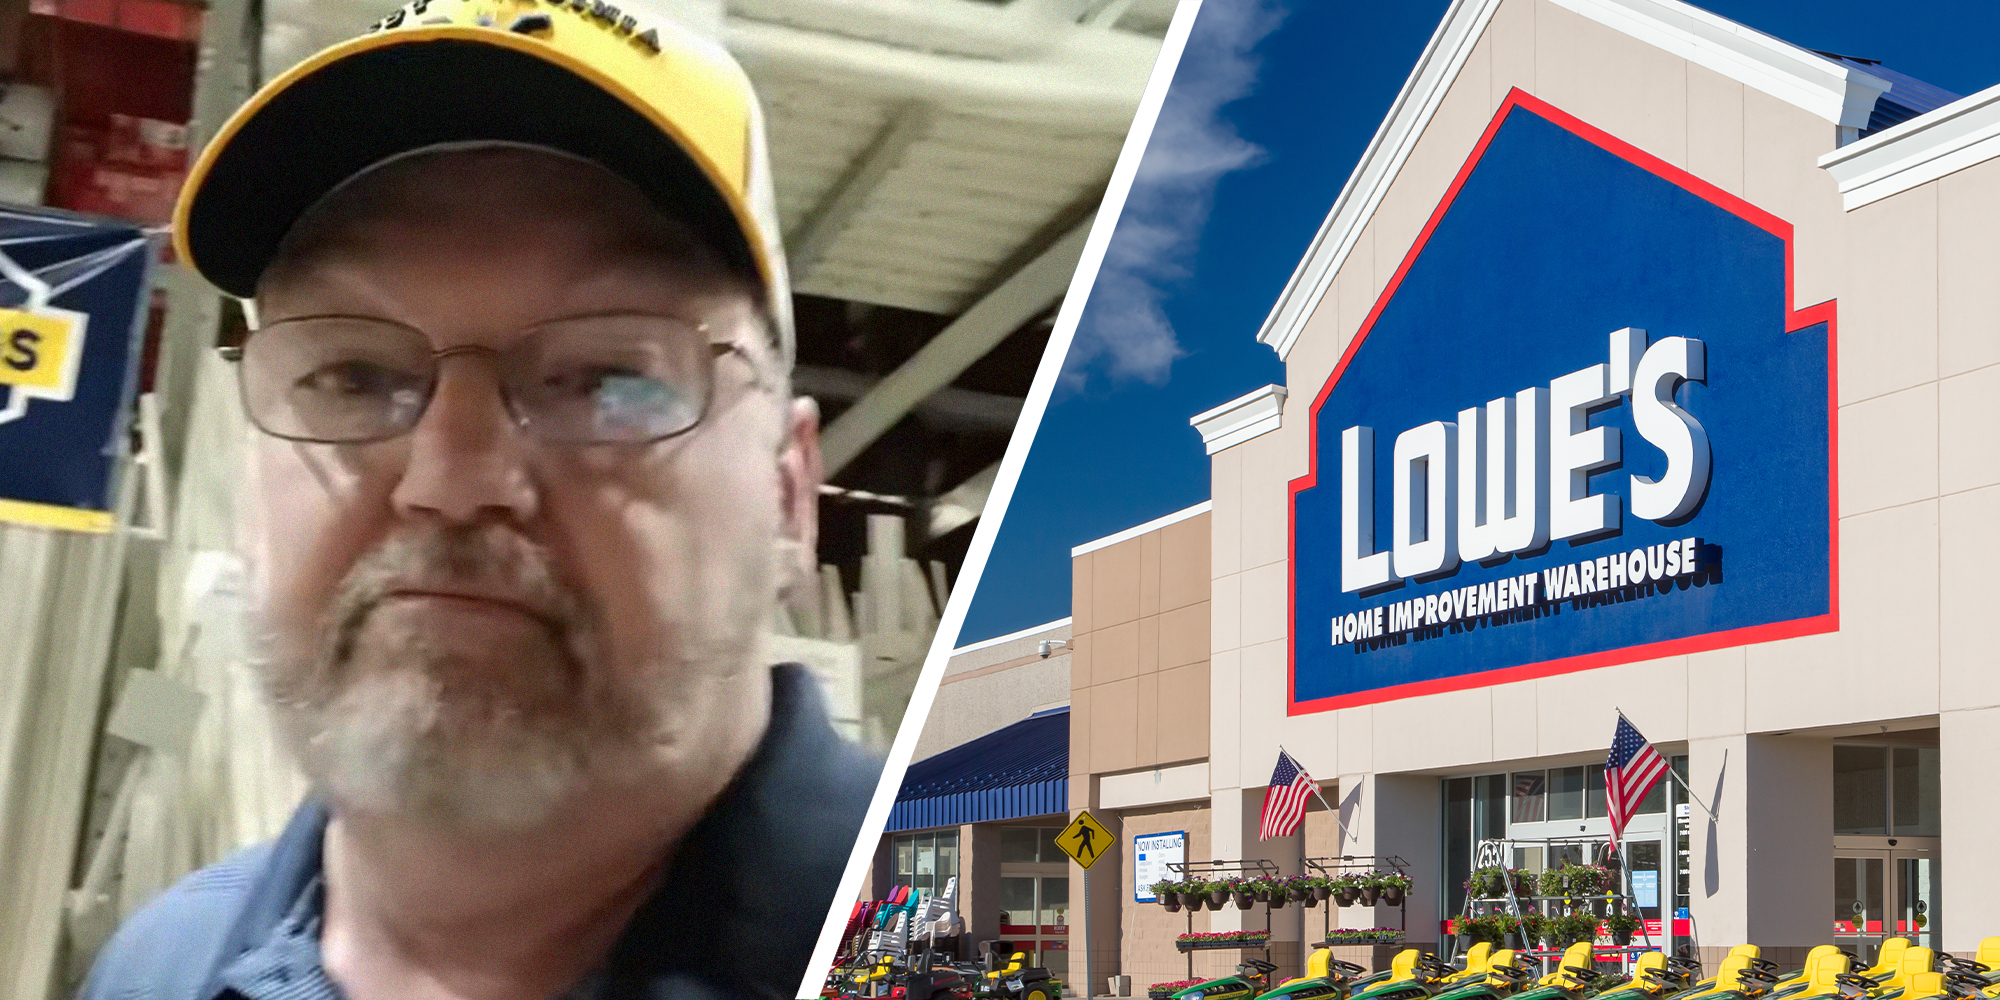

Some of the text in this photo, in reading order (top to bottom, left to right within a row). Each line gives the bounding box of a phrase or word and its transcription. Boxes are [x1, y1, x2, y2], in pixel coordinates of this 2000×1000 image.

[5, 329, 41, 372] S
[1342, 327, 1709, 593] LOWE'S
[1331, 537, 1696, 646] HOME IMPROVEMENT WAREHOUSE
[1138, 837, 1182, 852] NOW INSTALLING
